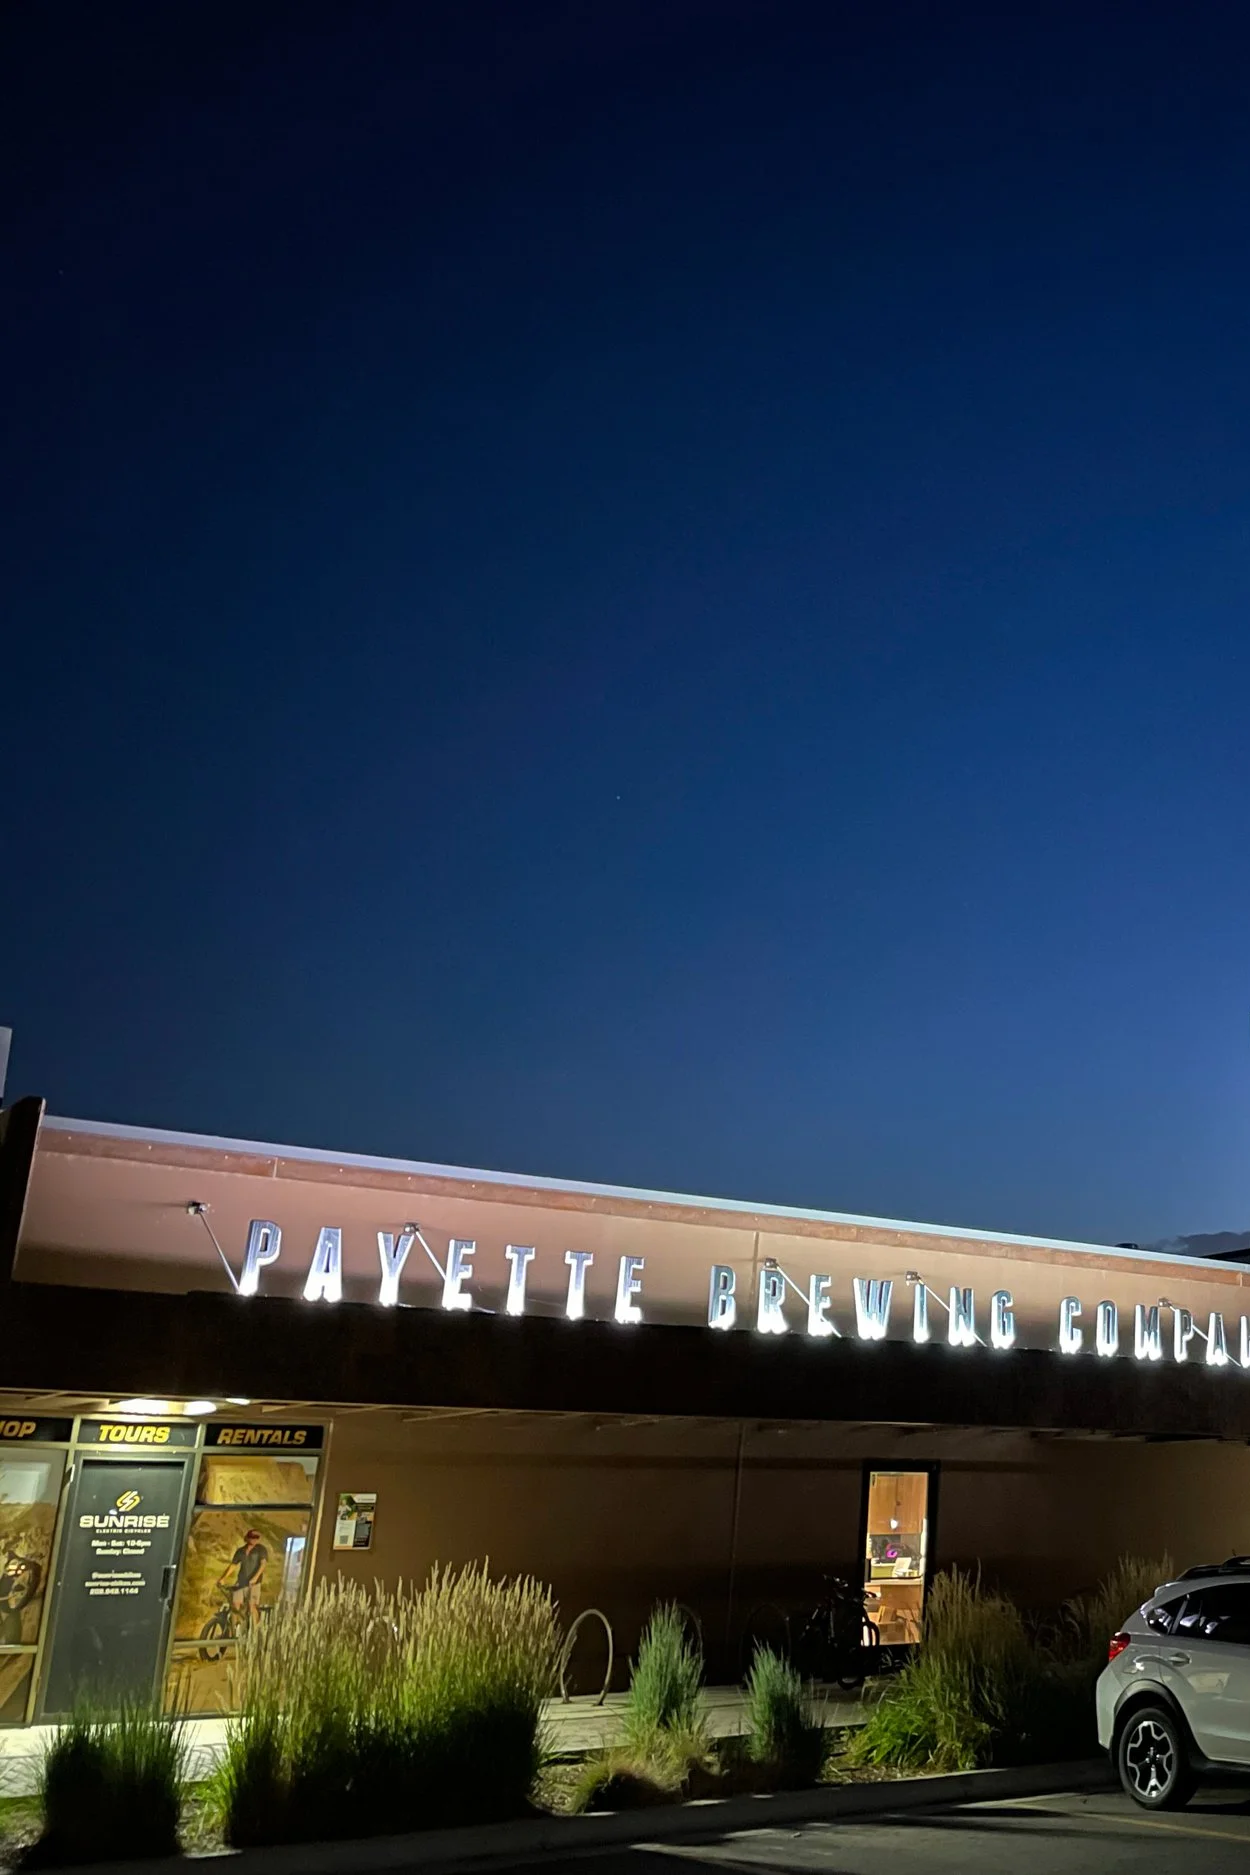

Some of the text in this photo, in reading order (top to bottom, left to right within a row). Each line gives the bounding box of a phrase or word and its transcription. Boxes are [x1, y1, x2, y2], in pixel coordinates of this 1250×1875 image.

[240, 1219, 646, 1324] PAYETTE
[708, 1264, 1014, 1350] BREWING
[99, 1424, 171, 1443] TOURS
[216, 1428, 307, 1445] RENTALS
[80, 1515, 170, 1528] SUNRISE
